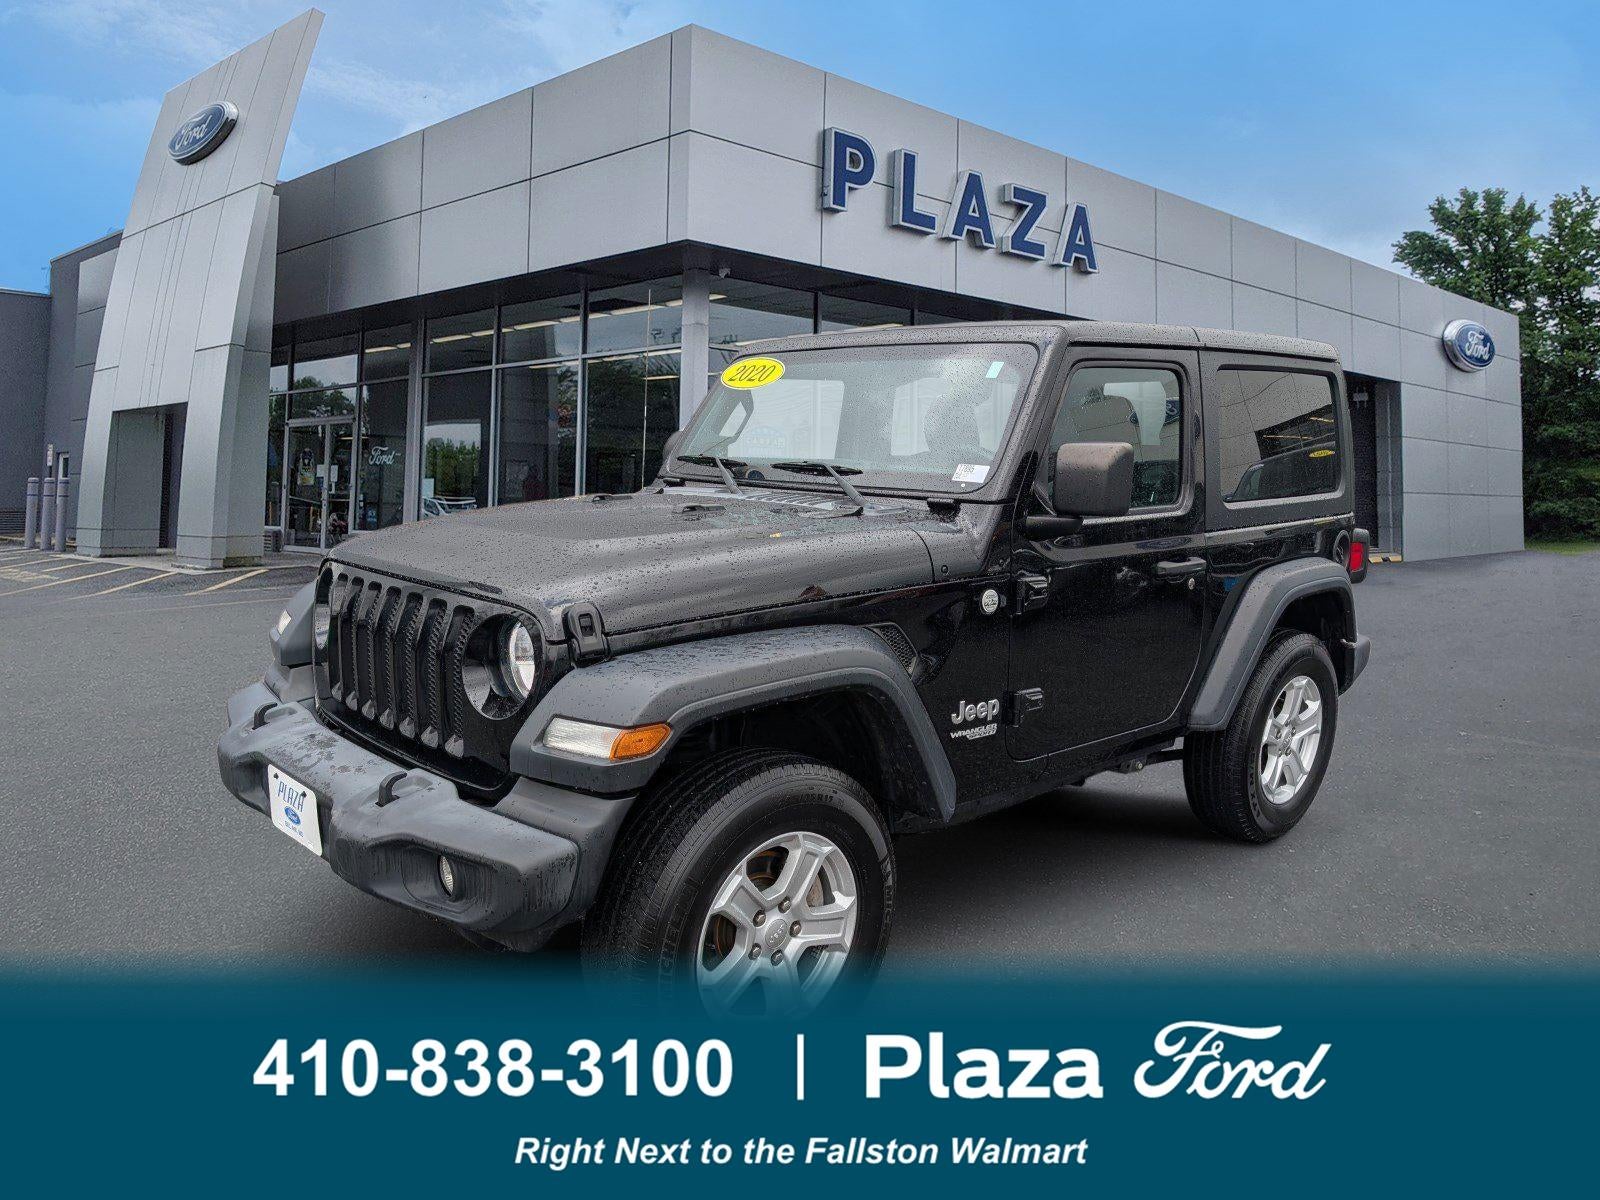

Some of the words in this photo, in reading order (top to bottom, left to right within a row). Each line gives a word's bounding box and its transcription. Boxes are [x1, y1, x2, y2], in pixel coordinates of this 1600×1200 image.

[174, 113, 213, 151] Ford
[823, 127, 1099, 274] PLAZA
[1464, 330, 1491, 361] Ford
[727, 364, 777, 382] 2020
[368, 445, 396, 466] Ford
[951, 698, 1000, 725] Jeep
[949, 722, 998, 739] WRANGLER
[277, 780, 306, 813] PLAZA
